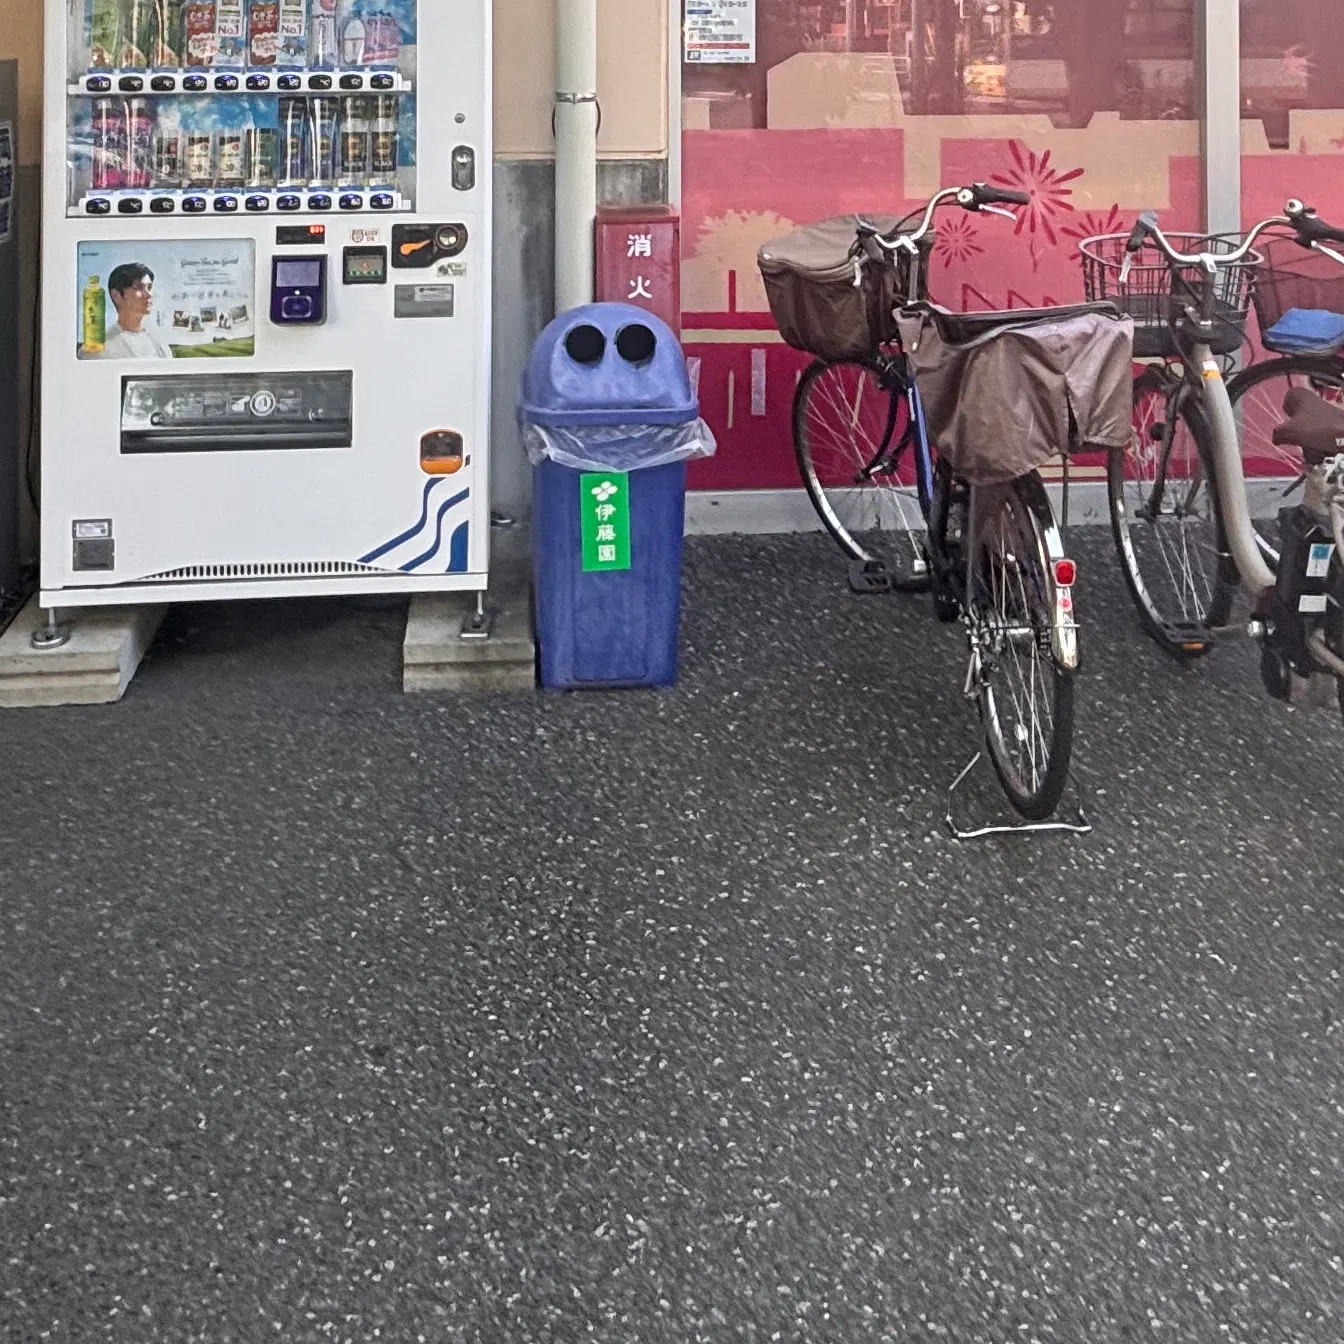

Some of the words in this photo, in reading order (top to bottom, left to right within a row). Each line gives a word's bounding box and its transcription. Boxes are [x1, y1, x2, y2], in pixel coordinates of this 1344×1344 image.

[626, 233, 653, 299] 消火
[594, 503, 617, 562] 伊藤園
